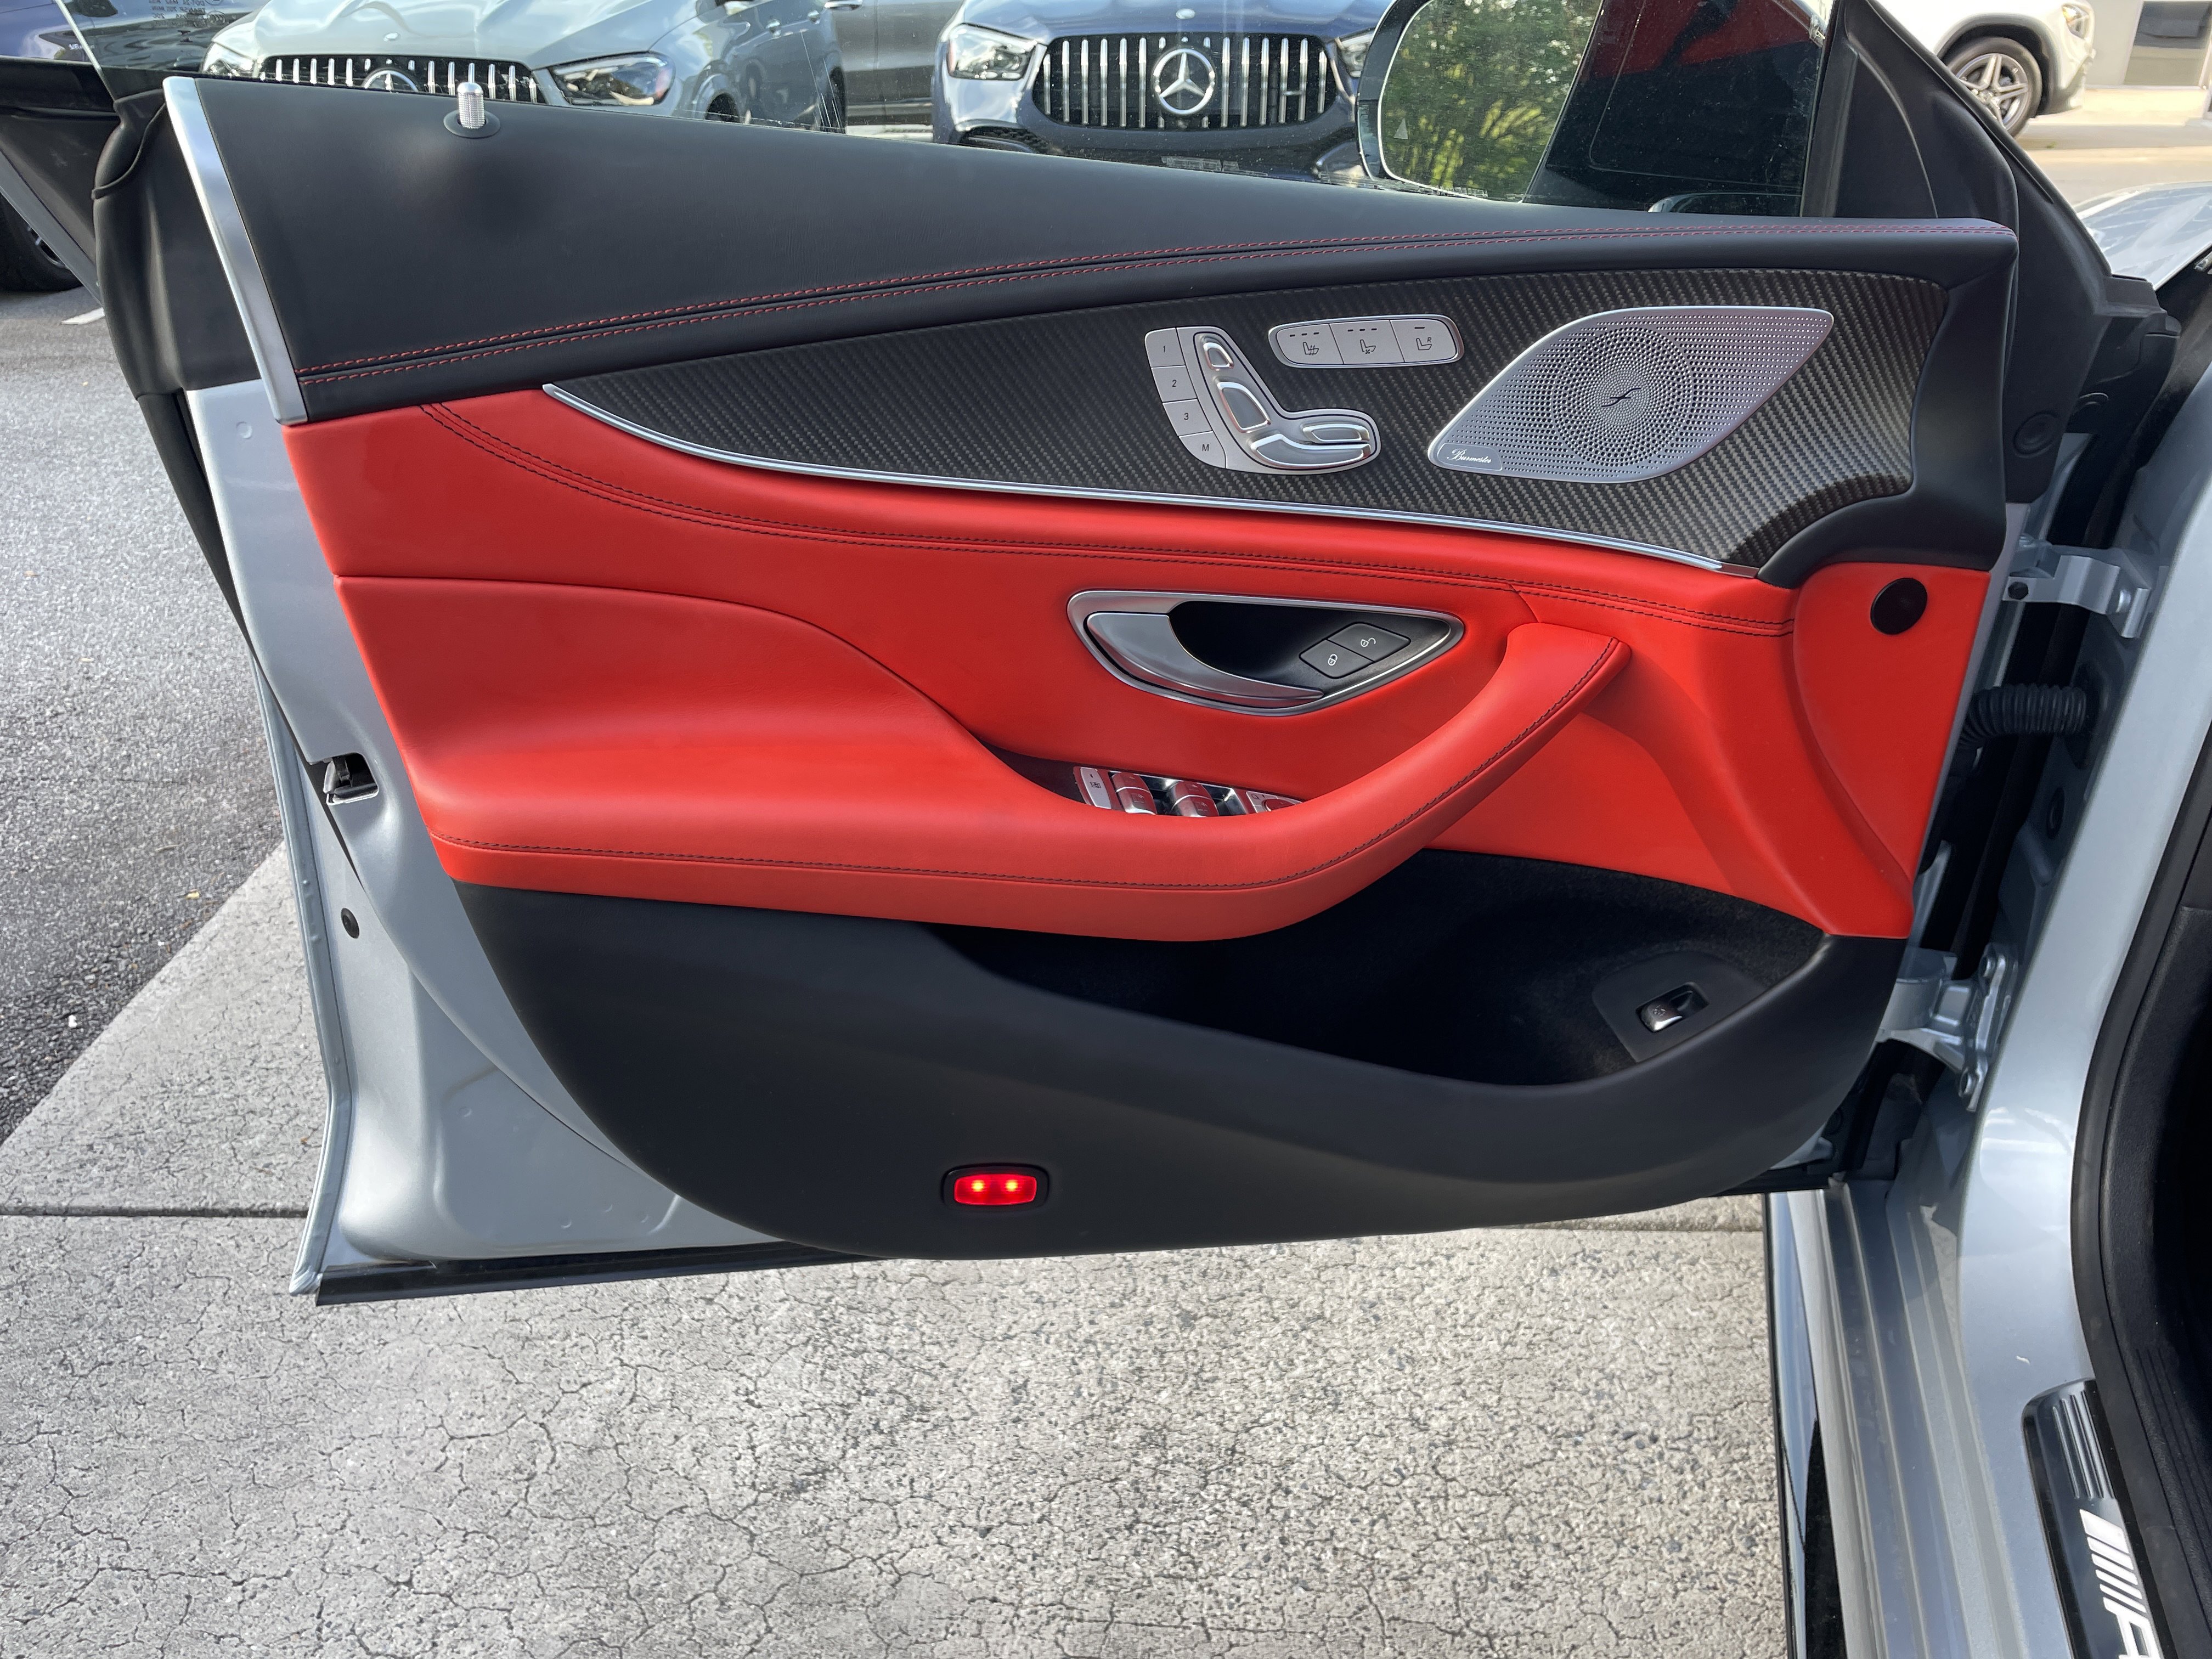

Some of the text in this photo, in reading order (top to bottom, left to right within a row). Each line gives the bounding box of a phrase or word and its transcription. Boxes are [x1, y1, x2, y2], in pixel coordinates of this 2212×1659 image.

[1172, 379, 1177, 387] 2
[1183, 413, 1189, 421] 3
[1447, 448, 1492, 464] Burmester
